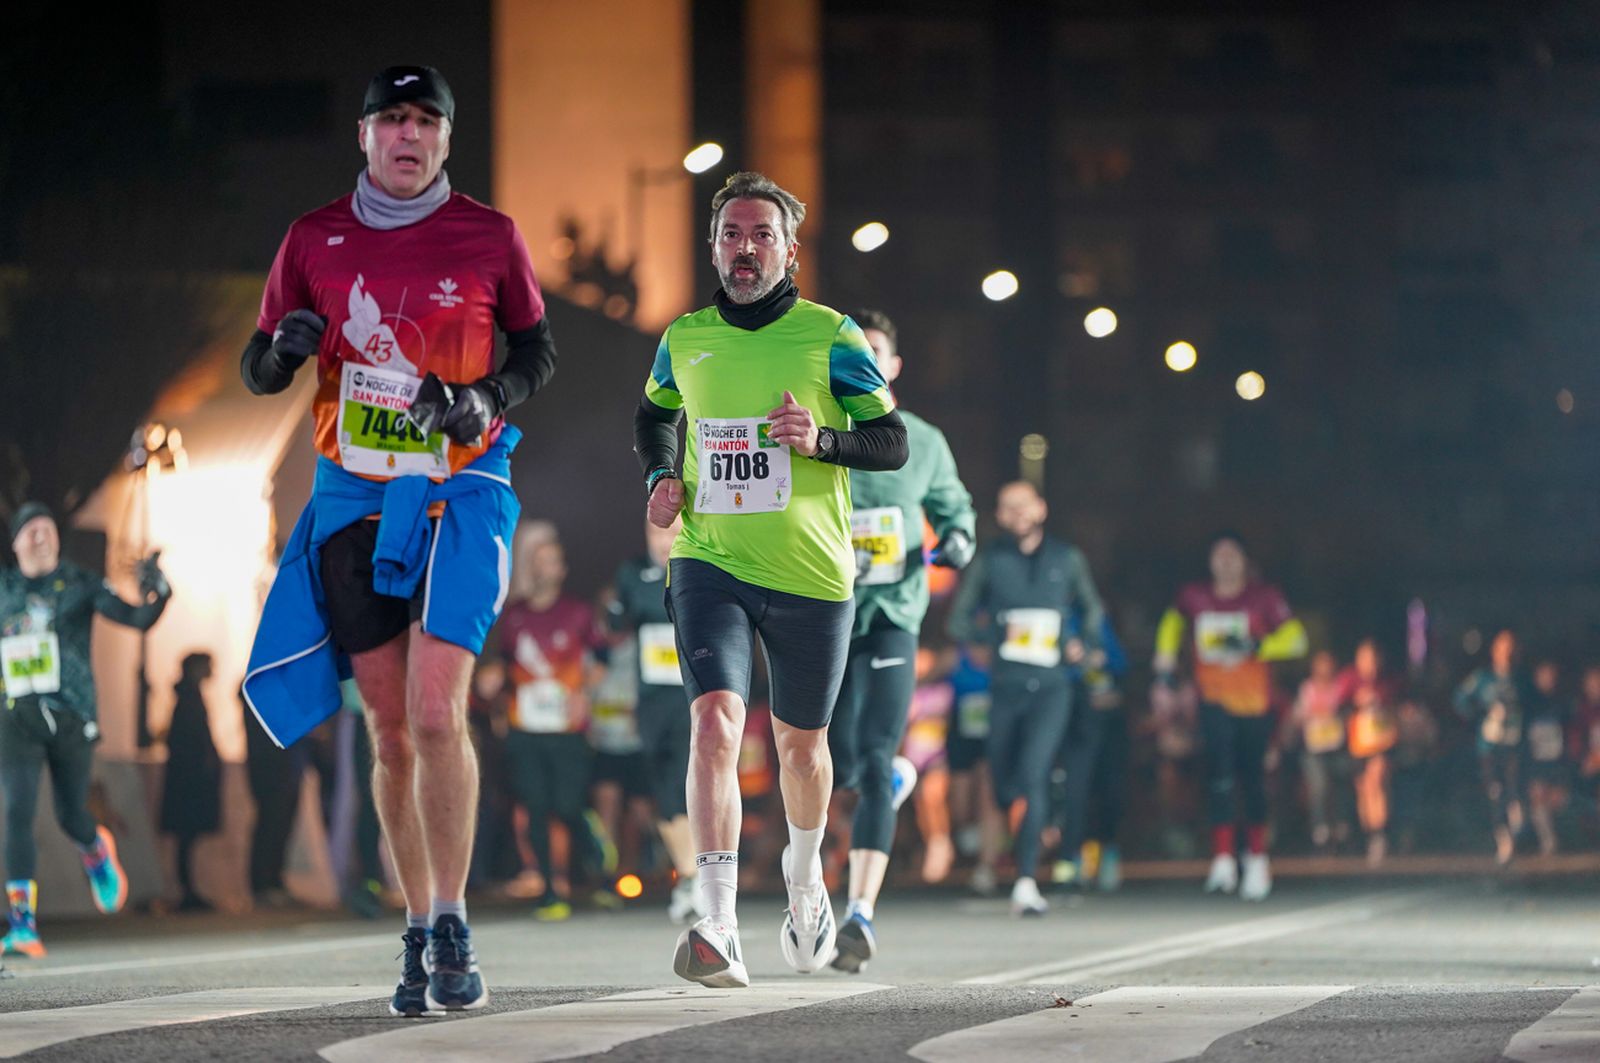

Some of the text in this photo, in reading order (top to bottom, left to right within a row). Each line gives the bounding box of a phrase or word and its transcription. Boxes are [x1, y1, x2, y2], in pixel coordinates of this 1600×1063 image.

[365, 334, 393, 362] 43
[352, 389, 373, 401] SAN
[365, 380, 397, 395] NOCHE
[400, 387, 413, 399] DE
[710, 428, 735, 439] NOCHE
[736, 428, 748, 438] DE
[704, 439, 717, 451] SAN
[717, 438, 749, 451] ANTÓN
[710, 451, 770, 482] 6708
